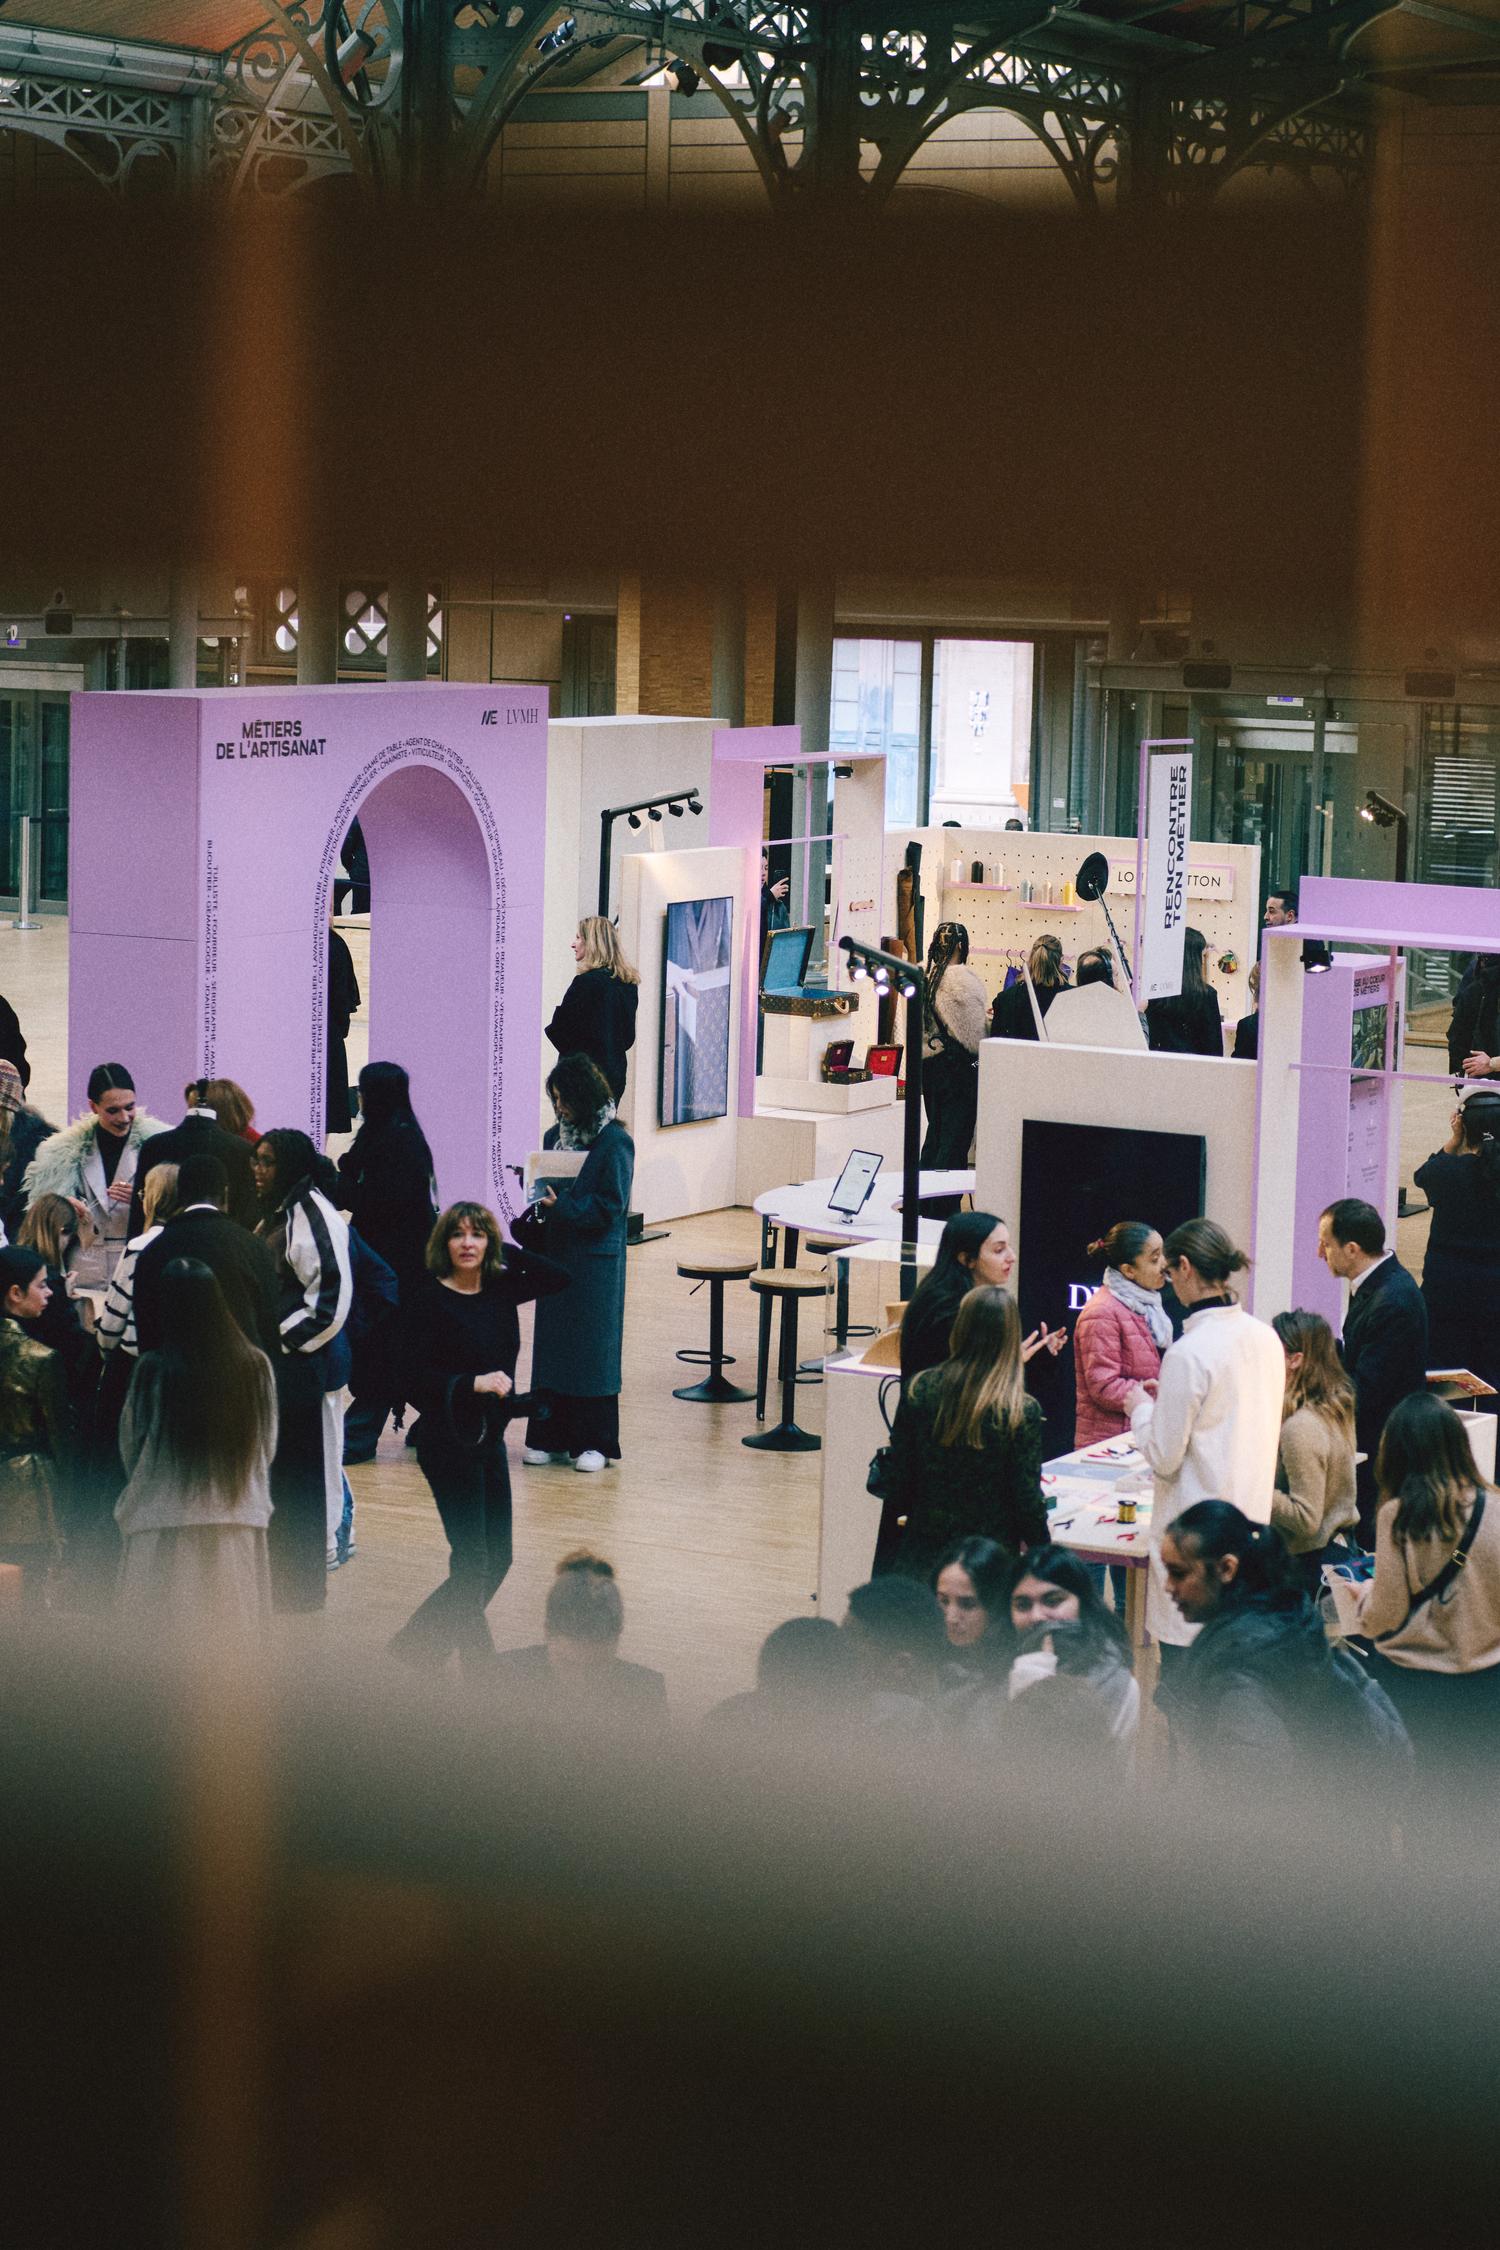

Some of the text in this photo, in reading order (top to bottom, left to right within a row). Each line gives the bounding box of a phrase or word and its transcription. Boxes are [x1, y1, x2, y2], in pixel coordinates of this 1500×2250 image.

[507, 708, 539, 724] LVMH
[242, 719, 302, 739] MÉTIERS
[216, 738, 327, 760] DE L'ARTISANAT
[1164, 765, 1179, 929] RENCONTRE
[1187, 875, 1221, 888] TTON
[1173, 871, 1183, 927] TON
